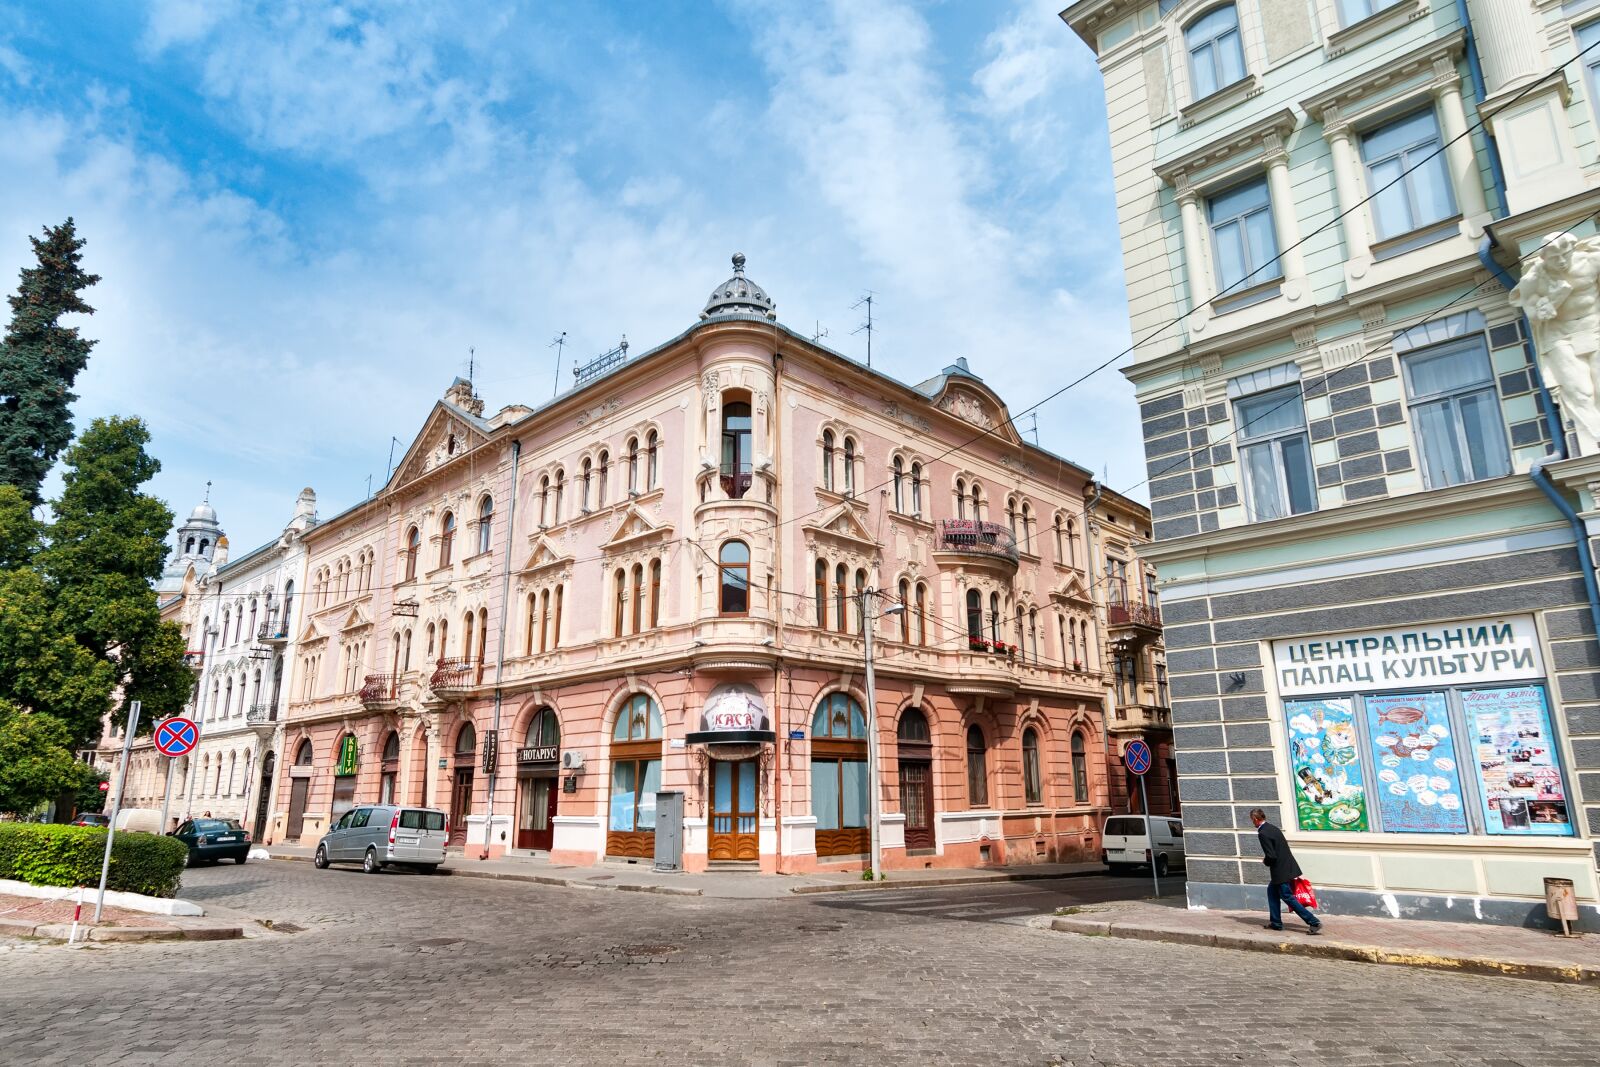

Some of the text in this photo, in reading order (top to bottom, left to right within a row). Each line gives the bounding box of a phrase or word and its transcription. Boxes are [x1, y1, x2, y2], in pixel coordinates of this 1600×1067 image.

[1281, 647, 1535, 687] ПАЛАЦ КУЛЬТУРИ
[715, 713, 752, 726] КАСА
[345, 738, 355, 774] КВІТИ
[488, 733, 496, 770] НОТАРІУС
[523, 747, 557, 761] НОТАРІУС
